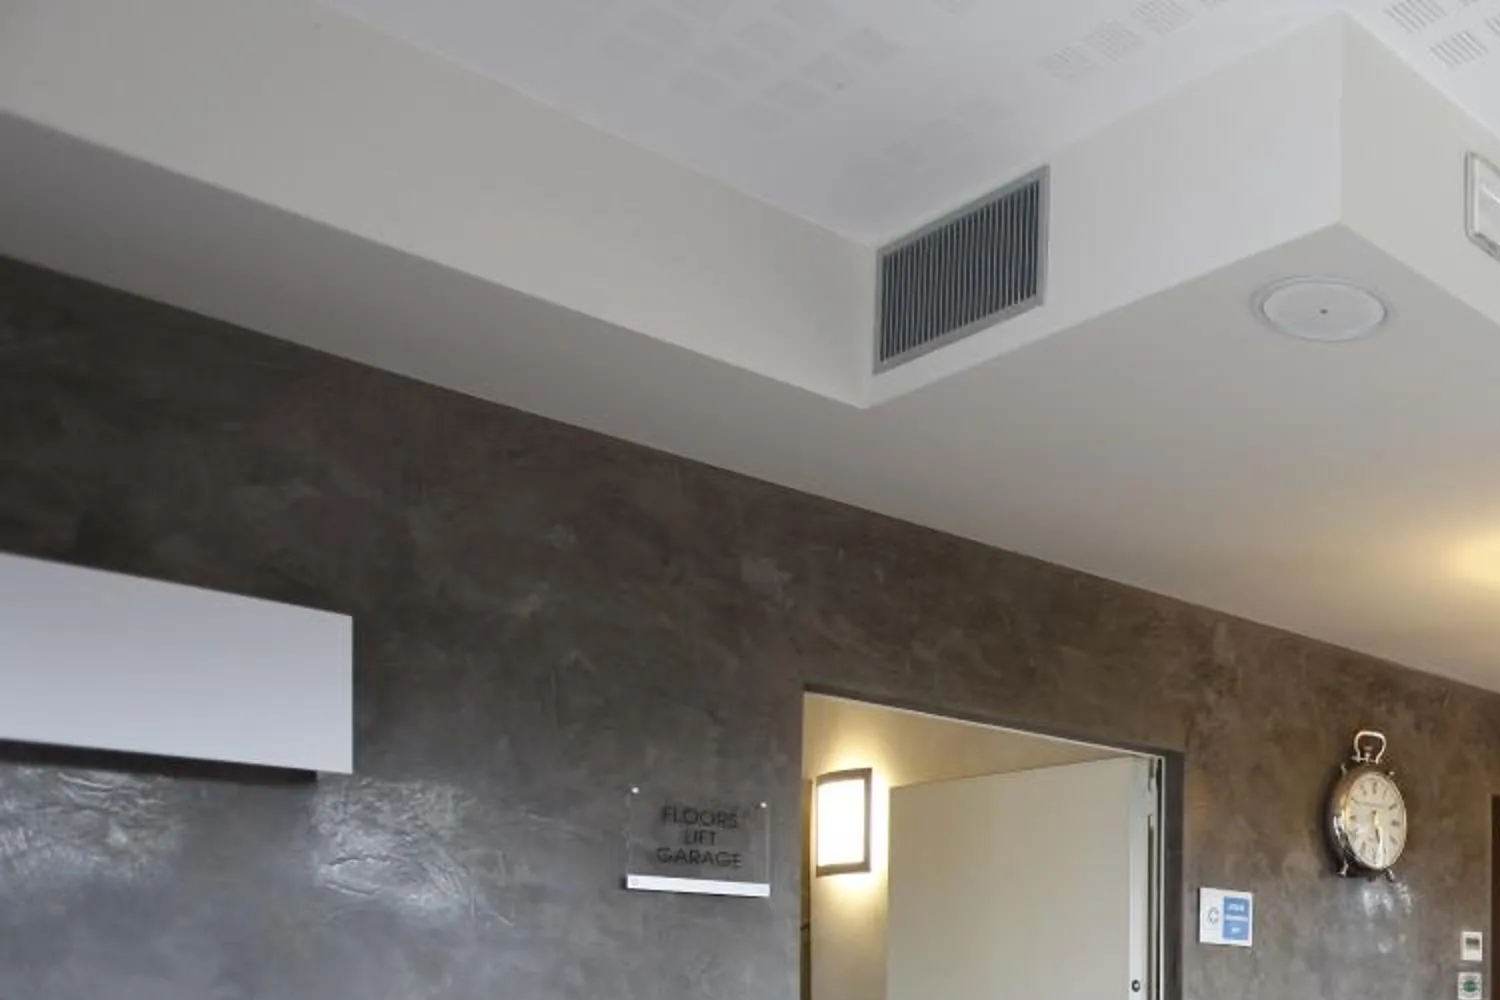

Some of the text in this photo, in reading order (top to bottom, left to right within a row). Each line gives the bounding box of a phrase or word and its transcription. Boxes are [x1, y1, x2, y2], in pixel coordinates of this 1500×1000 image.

[662, 806, 738, 829] FLOORS
[684, 829, 716, 846] LIFT
[656, 847, 743, 869] GARAGE
